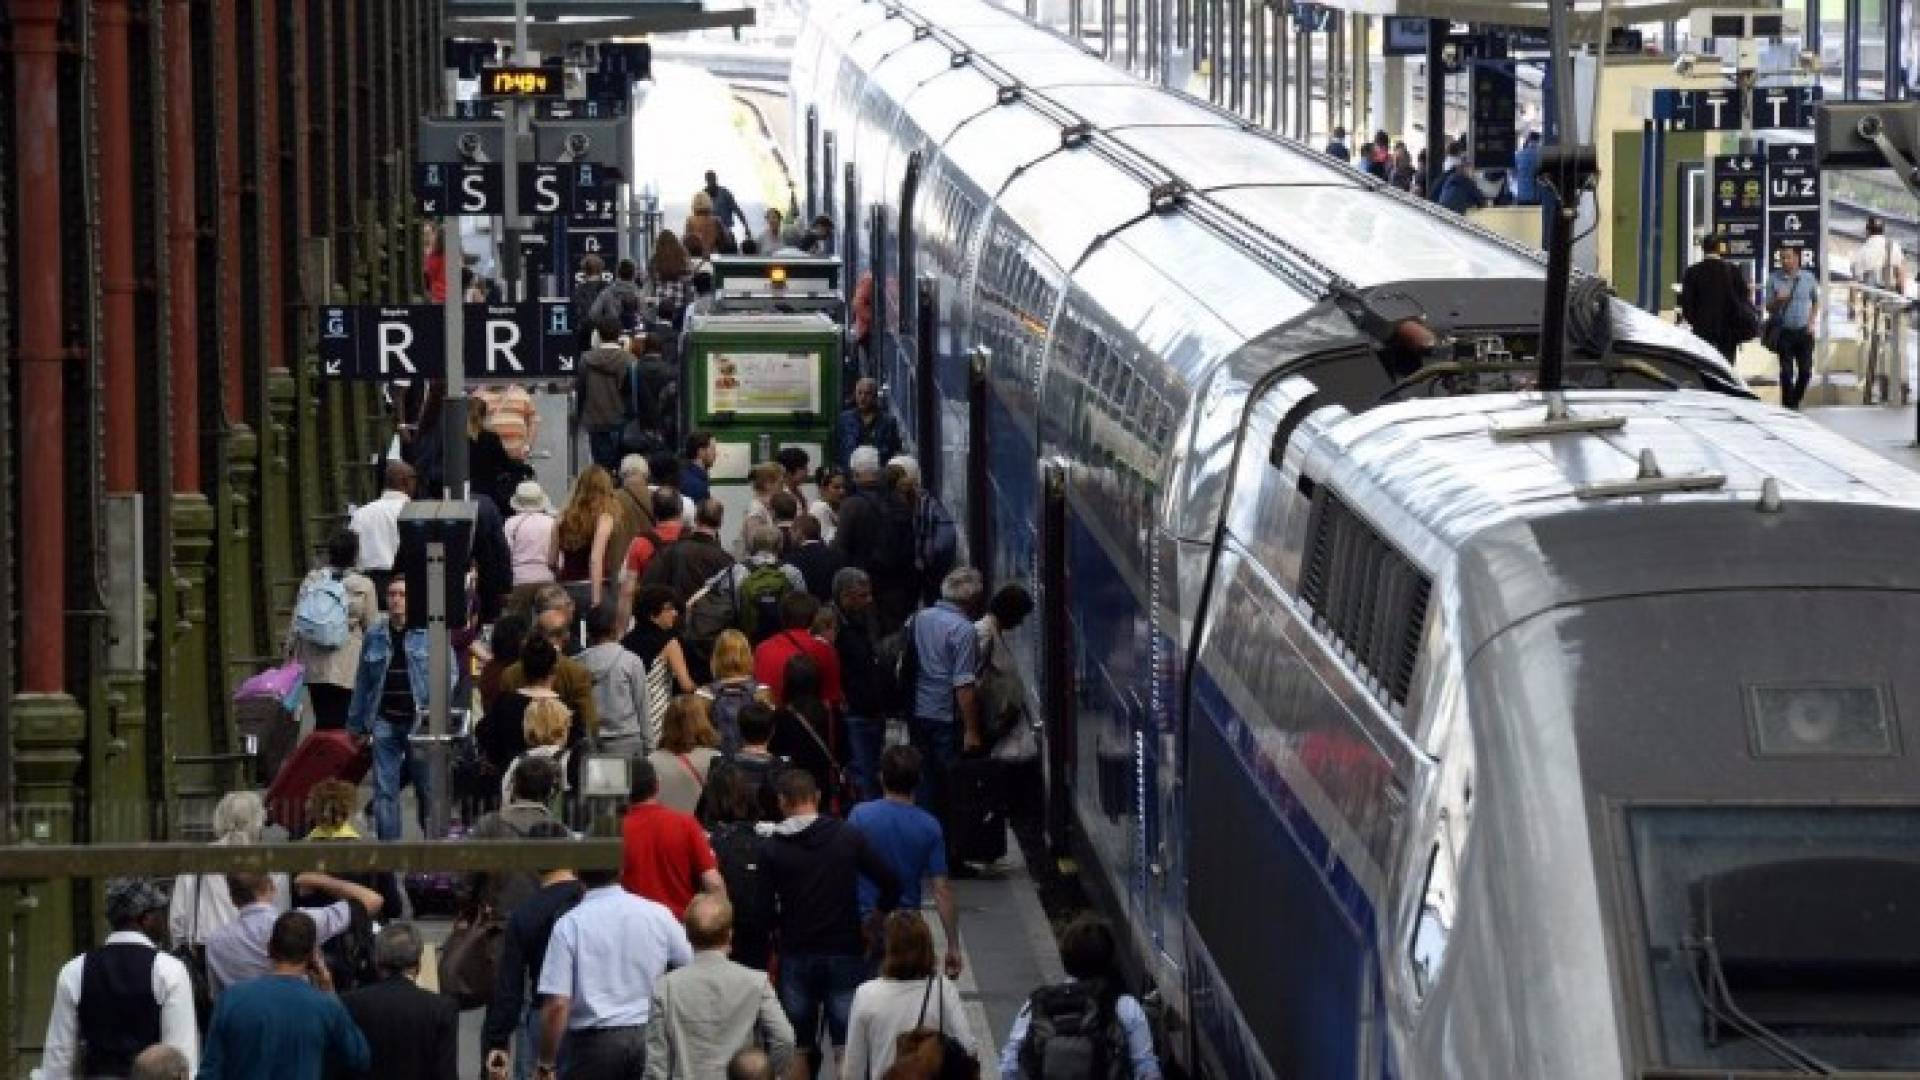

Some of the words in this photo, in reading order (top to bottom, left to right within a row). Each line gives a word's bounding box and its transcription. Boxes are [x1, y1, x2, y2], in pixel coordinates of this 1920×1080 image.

[1706, 97, 1729, 128] T
[1766, 96, 1789, 128] T
[462, 174, 487, 212] S
[536, 174, 560, 212] S
[1773, 178, 1789, 198] U
[1801, 178, 1816, 198] Z
[1801, 248, 1816, 268] R
[378, 322, 417, 374] R
[485, 320, 525, 371] R
